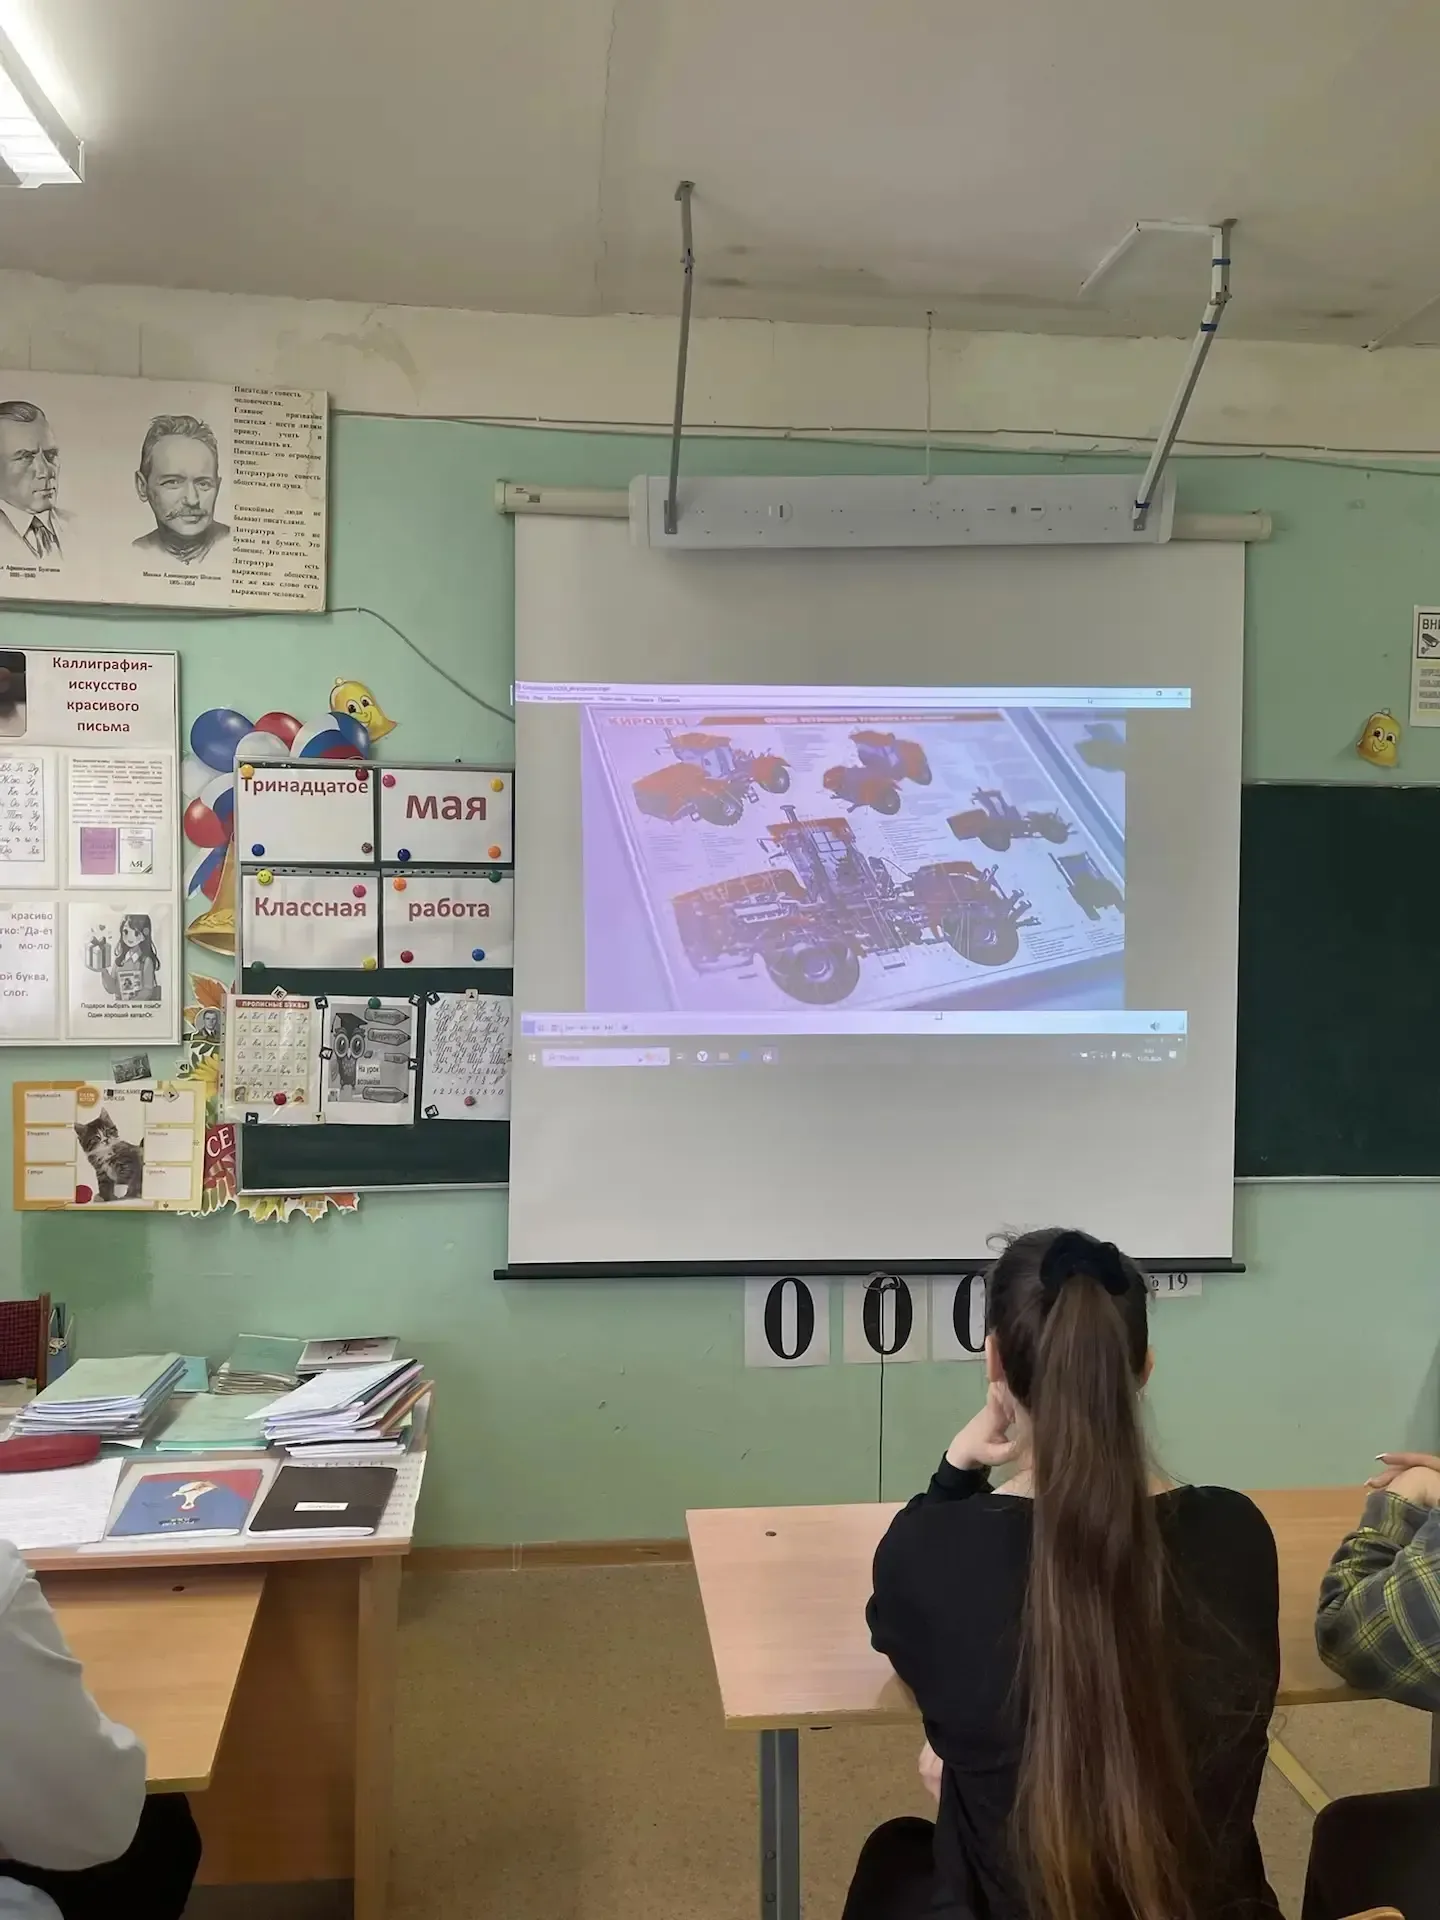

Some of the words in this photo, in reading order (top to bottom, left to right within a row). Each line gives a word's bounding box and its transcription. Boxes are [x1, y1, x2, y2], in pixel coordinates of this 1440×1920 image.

[53, 657, 153, 673] Каллиграфия-
[69, 680, 137, 693] искусство
[67, 700, 139, 714] красивого
[77, 722, 130, 733] письма
[608, 716, 688, 727] КИРОВЕЦ
[241, 777, 369, 796] Тринадцатое
[405, 795, 487, 821] мая
[255, 897, 366, 917] Классная
[408, 898, 490, 921] работа
[11, 913, 53, 921] красиво
[16, 972, 49, 982] буква,
[242, 1000, 282, 1008] ПРОПИСНЫЕ
[367, 1066, 379, 1074] урок
[1168, 1273, 1188, 1291] 19
